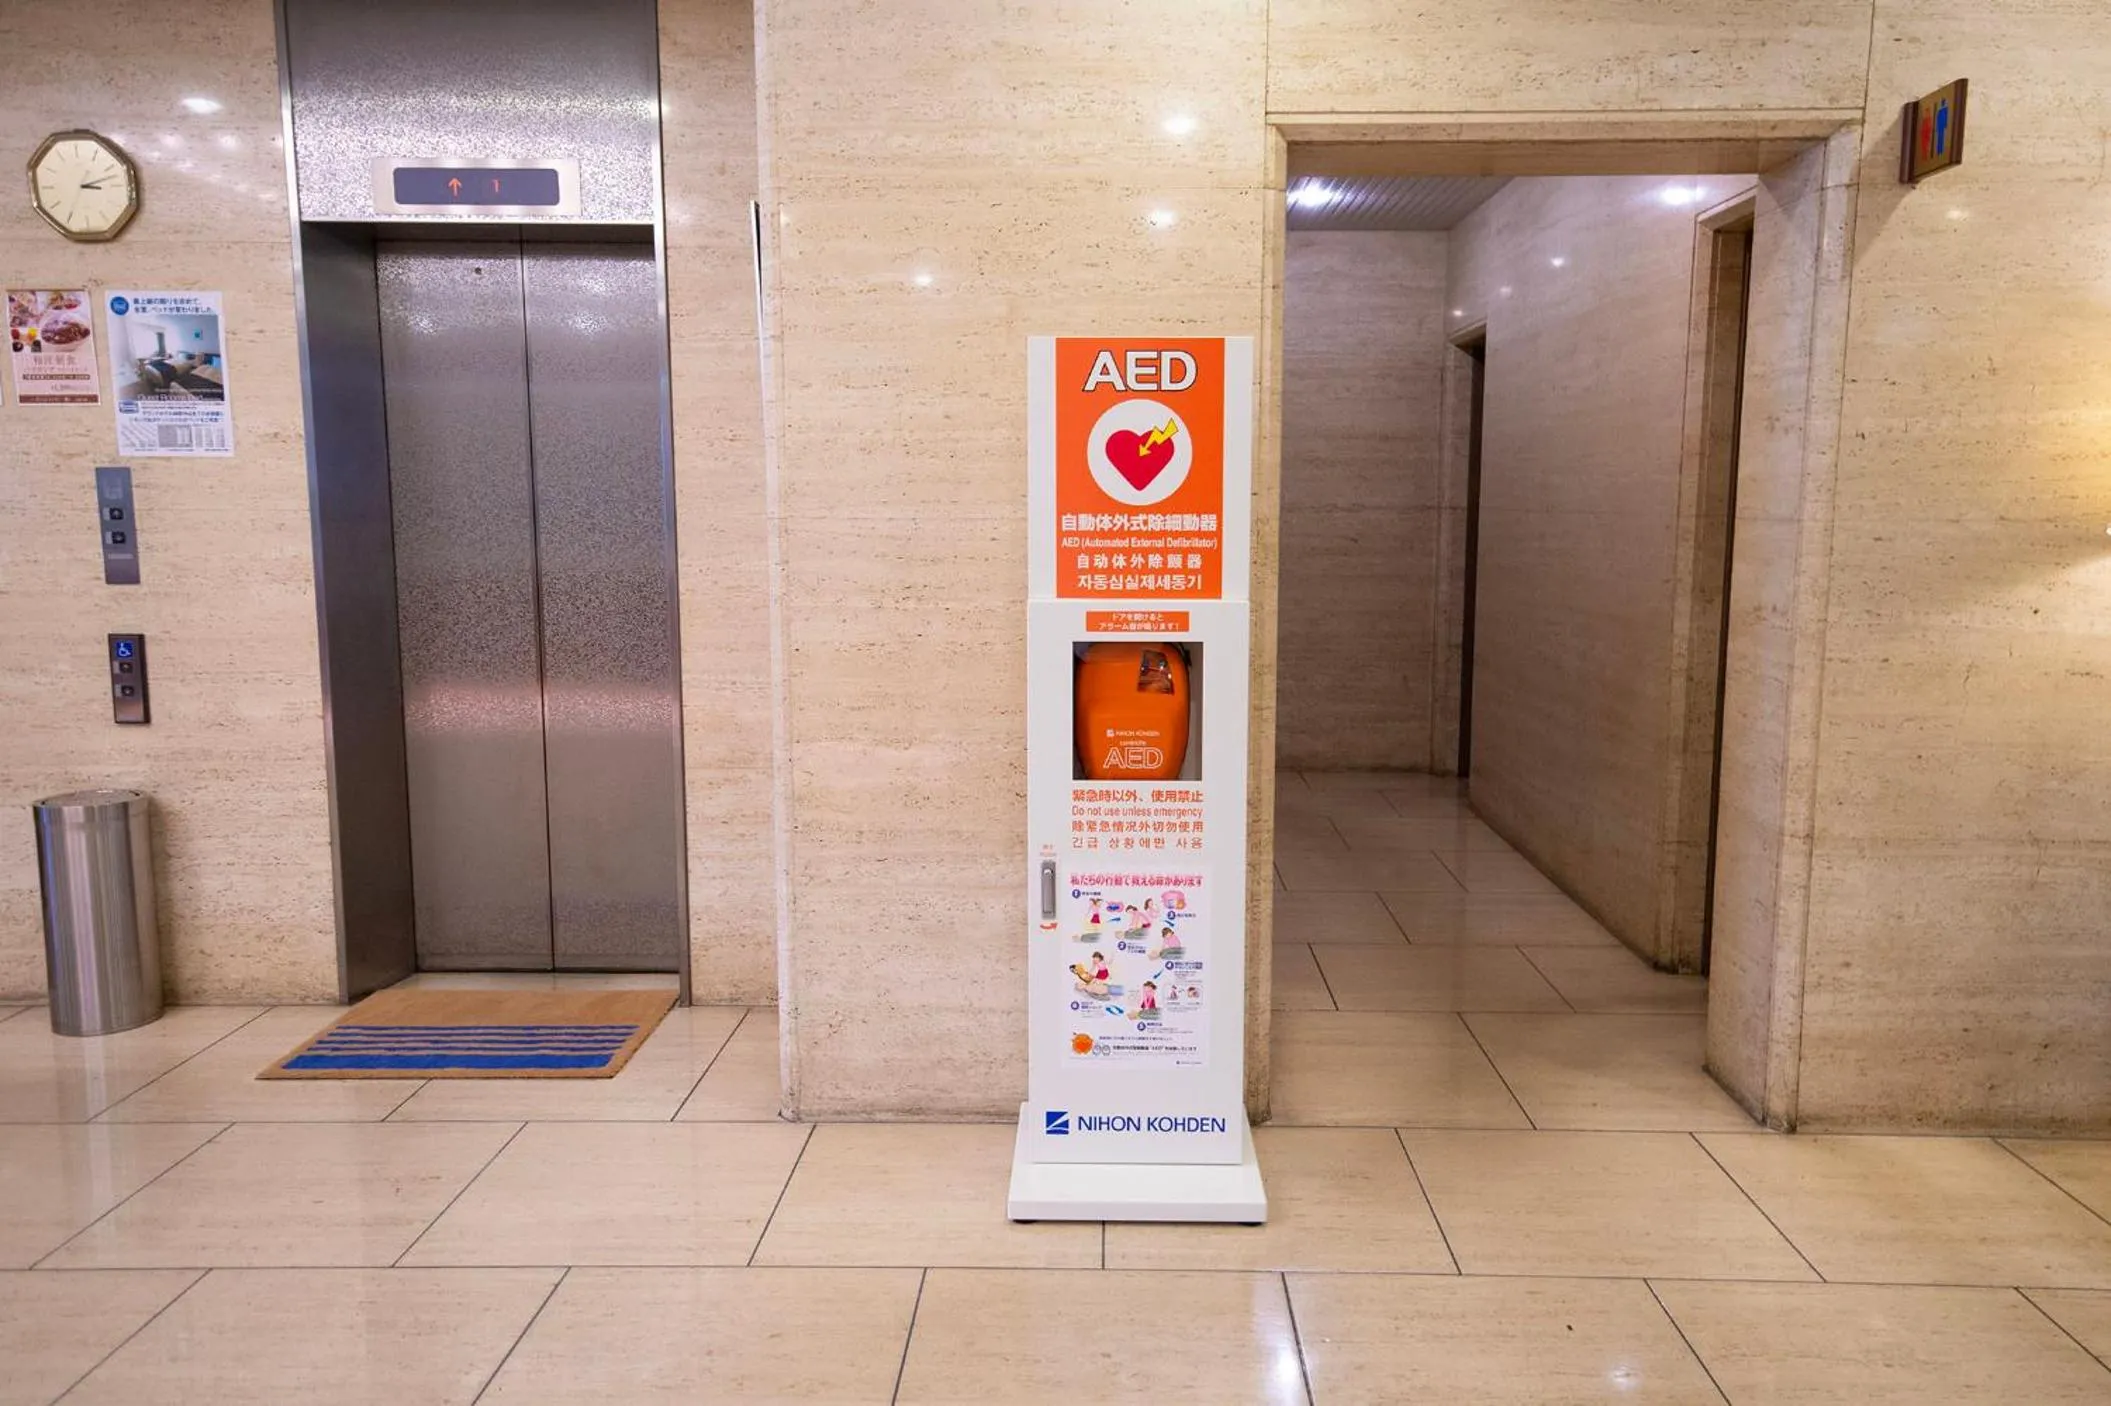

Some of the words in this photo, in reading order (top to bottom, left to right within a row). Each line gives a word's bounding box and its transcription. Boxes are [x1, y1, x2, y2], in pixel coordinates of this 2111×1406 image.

[491, 178, 500, 193] 1
[1081, 348, 1198, 394] AED
[1061, 513, 1218, 532] 自動体外式除細動器
[1061, 538, 1080, 548] AED
[1081, 537, 1130, 550] (Automated
[1131, 537, 1165, 548] External
[1166, 537, 1218, 550] Defibrillator)
[1077, 574, 1202, 592] 자동심실제세동기
[1111, 612, 1165, 622] ドアを開けると
[1103, 746, 1164, 770] AED
[1072, 789, 1204, 803] 緊急時以外、使用禁止
[1071, 805, 1084, 816] Do
[1086, 806, 1102, 816] not
[1104, 807, 1121, 816] use
[1122, 806, 1152, 816] unless
[1153, 807, 1203, 819] emergency
[1072, 836, 1099, 849] 긴급
[1175, 836, 1204, 850] 사용
[1078, 1115, 1141, 1132] NIHON
[1147, 1116, 1226, 1133] KOHDEN
